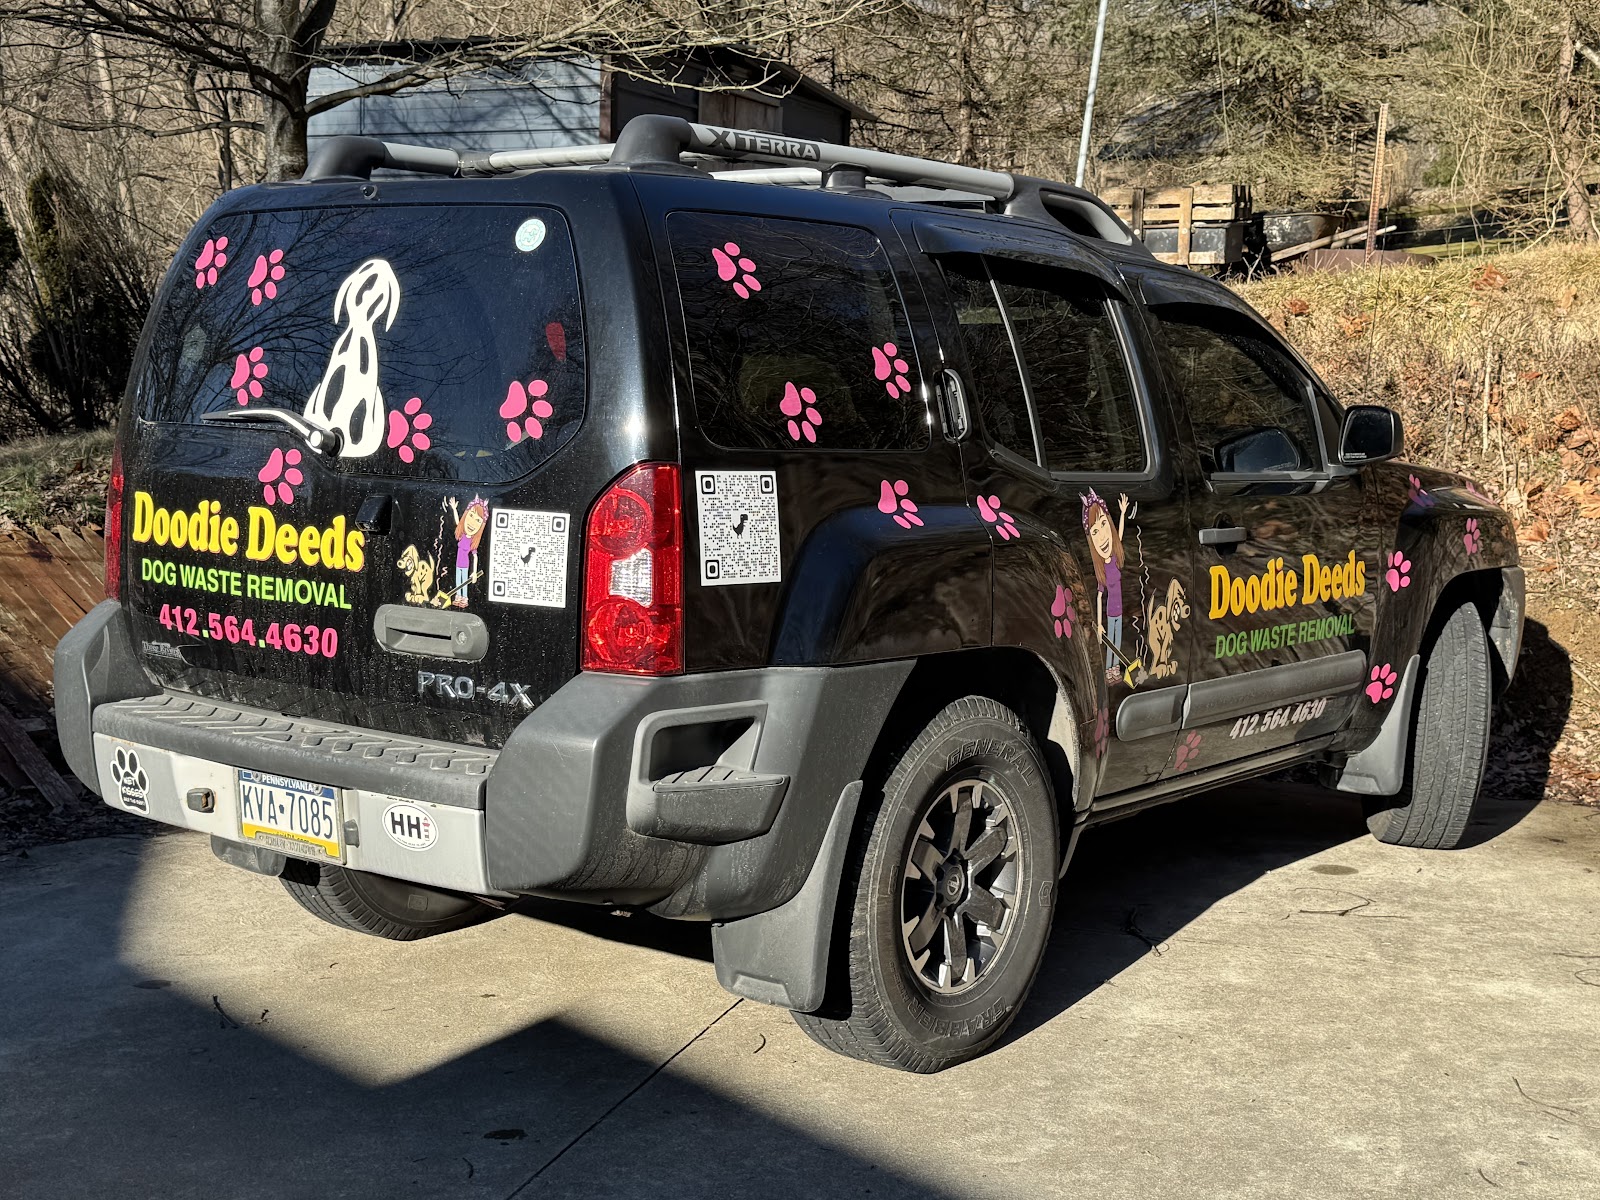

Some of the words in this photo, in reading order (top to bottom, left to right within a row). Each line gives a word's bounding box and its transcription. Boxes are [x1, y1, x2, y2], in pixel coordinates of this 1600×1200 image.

[706, 128, 818, 161] XTERRA
[131, 490, 240, 557] Doodie
[245, 505, 365, 572] Deeds
[141, 557, 177, 586] DOG
[179, 564, 243, 597] WASTE
[247, 574, 353, 610] REMOVAL
[1209, 556, 1298, 620] Doodie
[1301, 549, 1366, 605] Deeds
[158, 603, 339, 659] 412.564.4630
[1215, 630, 1248, 660] DOG
[1249, 622, 1297, 653] WASTE
[1298, 612, 1356, 645] REMOVAL
[417, 670, 535, 709] PRO-4X
[1229, 697, 1328, 740] 412.564.4630
[261, 774, 314, 793] PENNSYLVANIA
[945, 738, 1035, 787] GENERAL
[390, 811, 422, 840] HH
